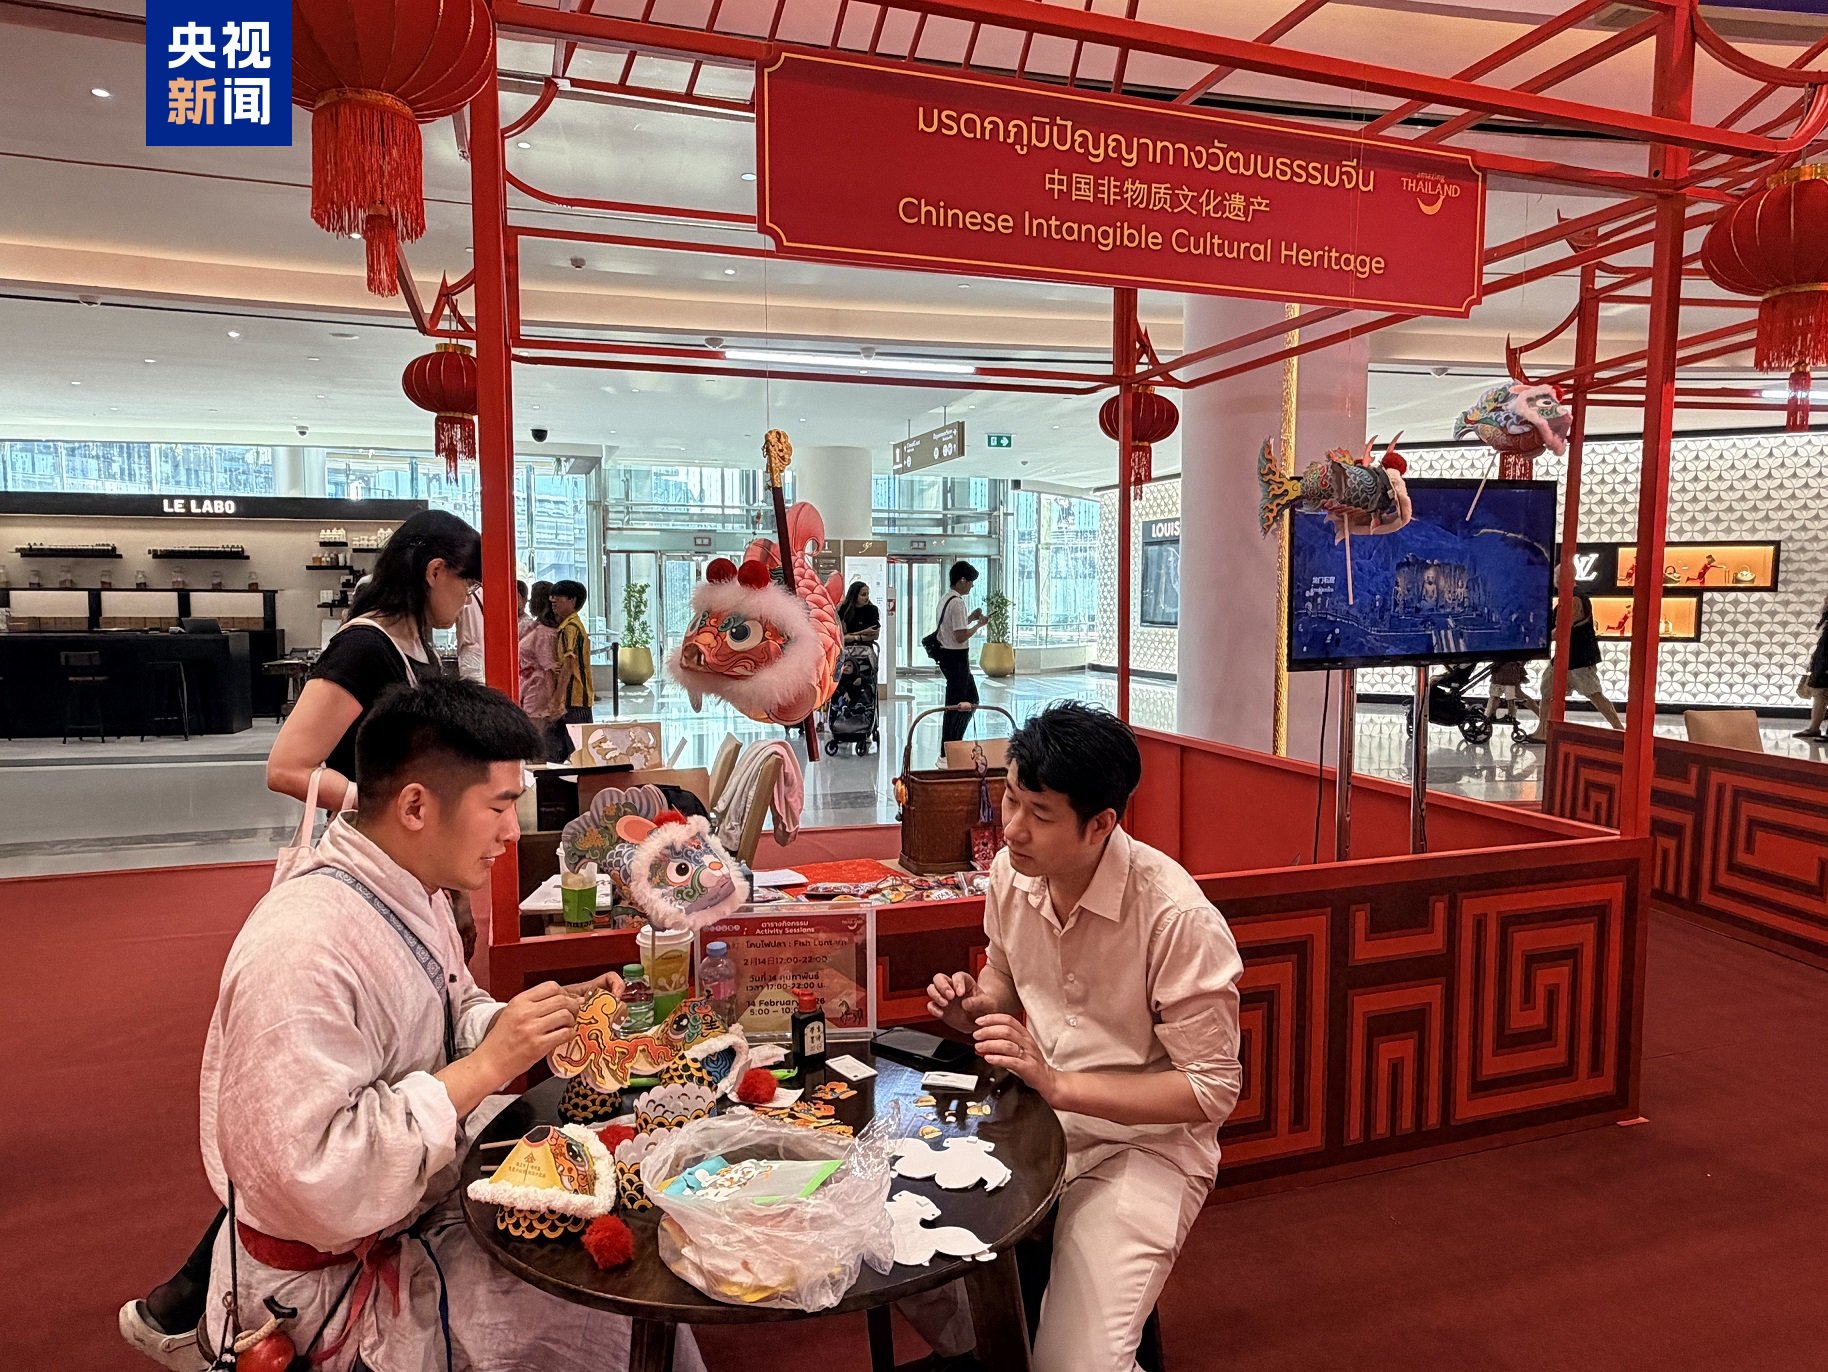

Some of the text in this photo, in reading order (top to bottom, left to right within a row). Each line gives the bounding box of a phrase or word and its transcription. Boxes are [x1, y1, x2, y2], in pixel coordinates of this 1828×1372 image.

[917, 106, 1375, 192] มรดกภูมิปัญญาทางวัฒนธรรมจีน
[1045, 168, 1270, 222] 中国非物质文化遗产
[1400, 177, 1461, 197] THAILAND
[898, 197, 1385, 279] Chinese Intangible Cultural Heritage
[163, 499, 236, 514] LE LABO
[1152, 522, 1180, 538] LOUIS
[758, 999, 800, 1007] February
